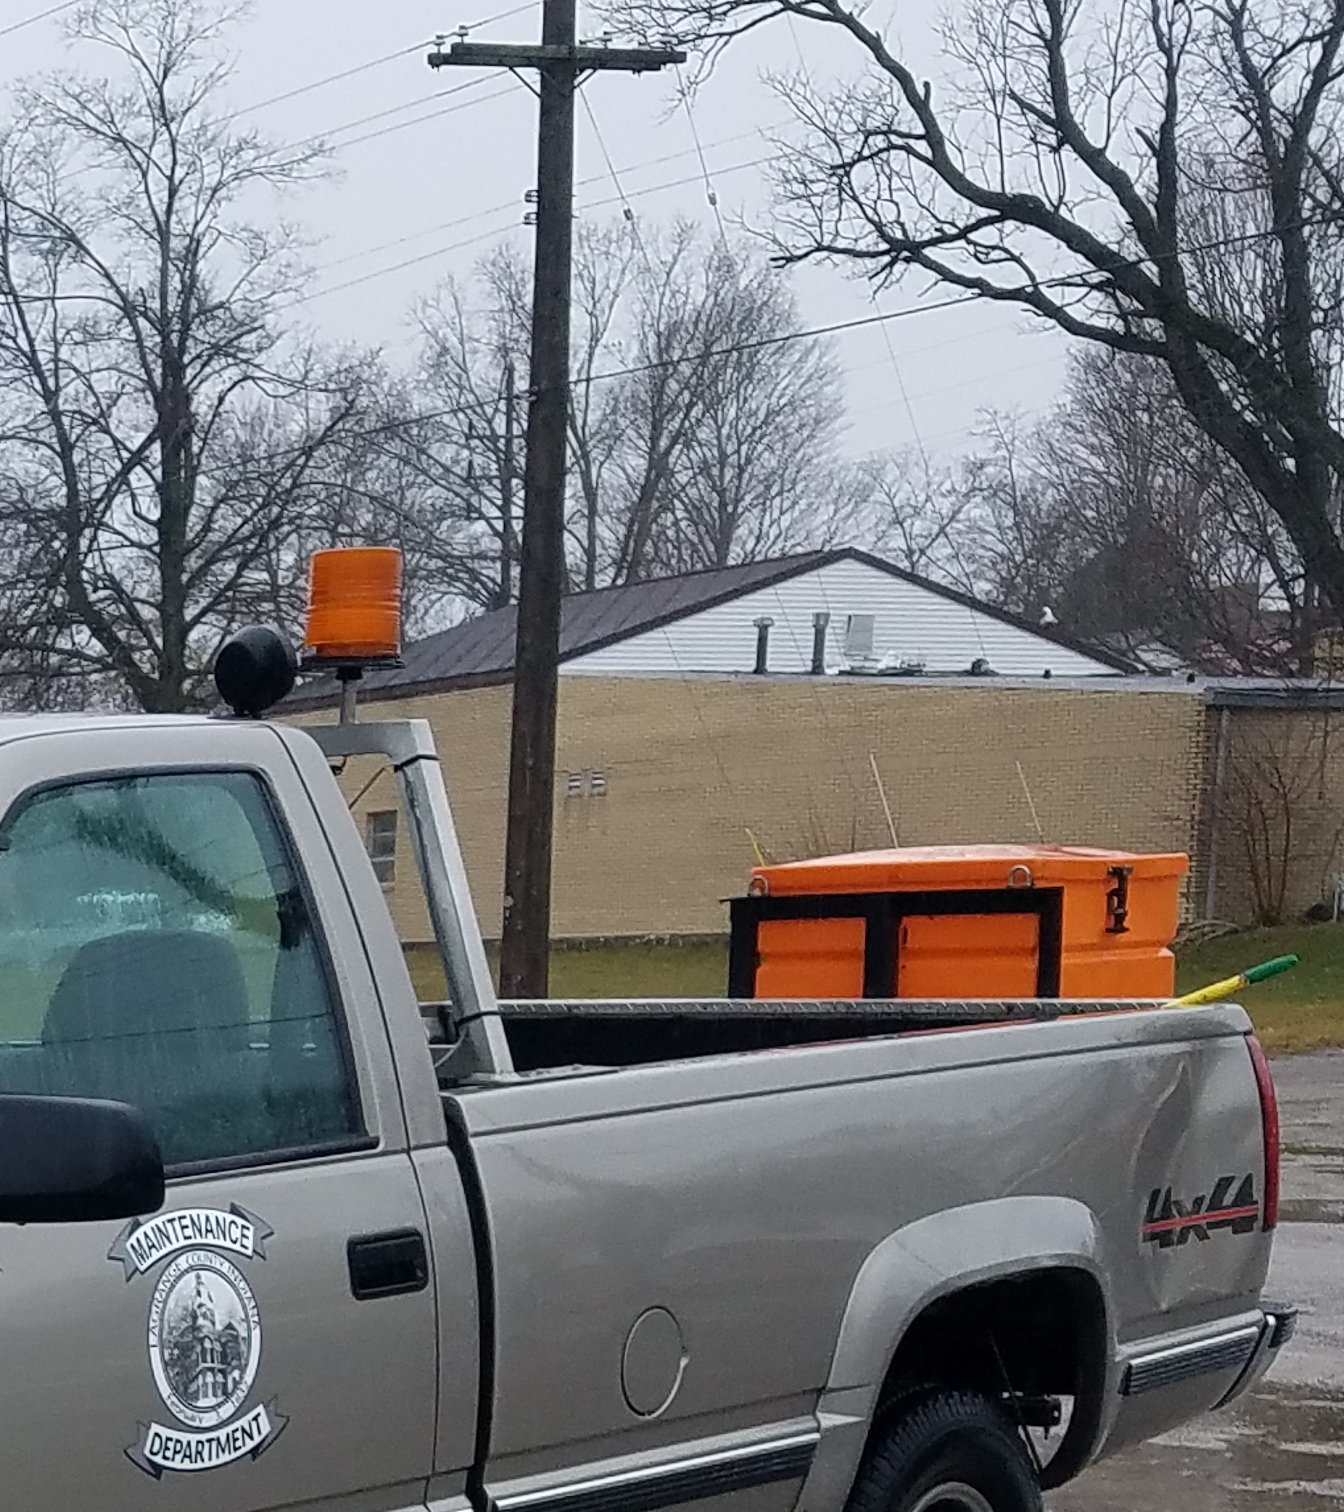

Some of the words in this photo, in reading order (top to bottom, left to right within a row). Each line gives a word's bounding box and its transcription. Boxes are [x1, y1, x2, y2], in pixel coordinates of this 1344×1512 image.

[1140, 1172, 1259, 1249] 4x4
[130, 1213, 251, 1266] MAINTENANCE
[149, 1412, 263, 1464] DEPARTMENT
